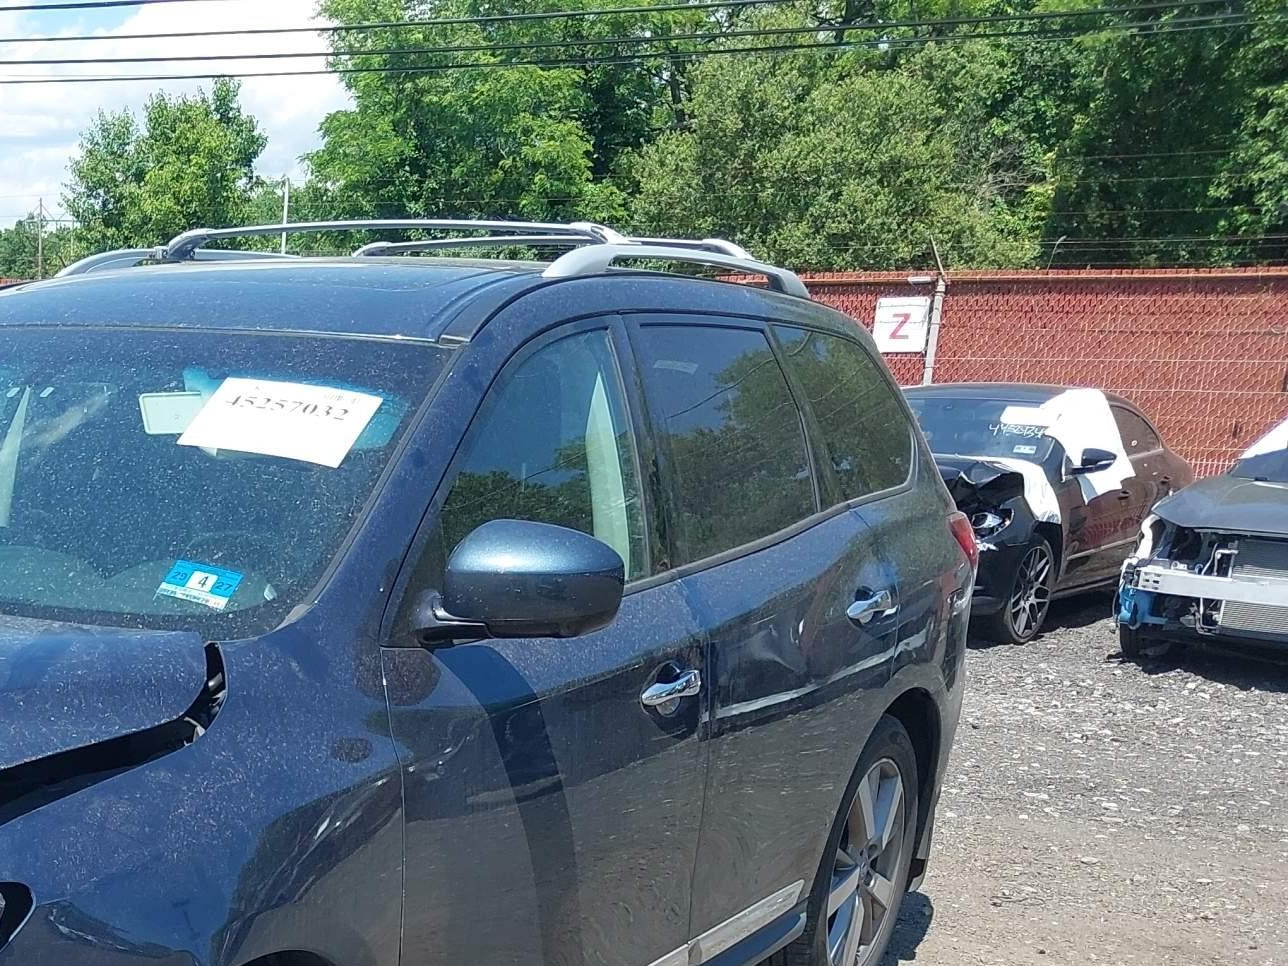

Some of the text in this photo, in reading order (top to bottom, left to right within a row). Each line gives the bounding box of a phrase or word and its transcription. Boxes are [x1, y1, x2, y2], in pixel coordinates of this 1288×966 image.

[888, 313, 911, 339] Z
[225, 394, 350, 421] 45257032
[197, 575, 210, 589] 4
[214, 580, 233, 592] 27
